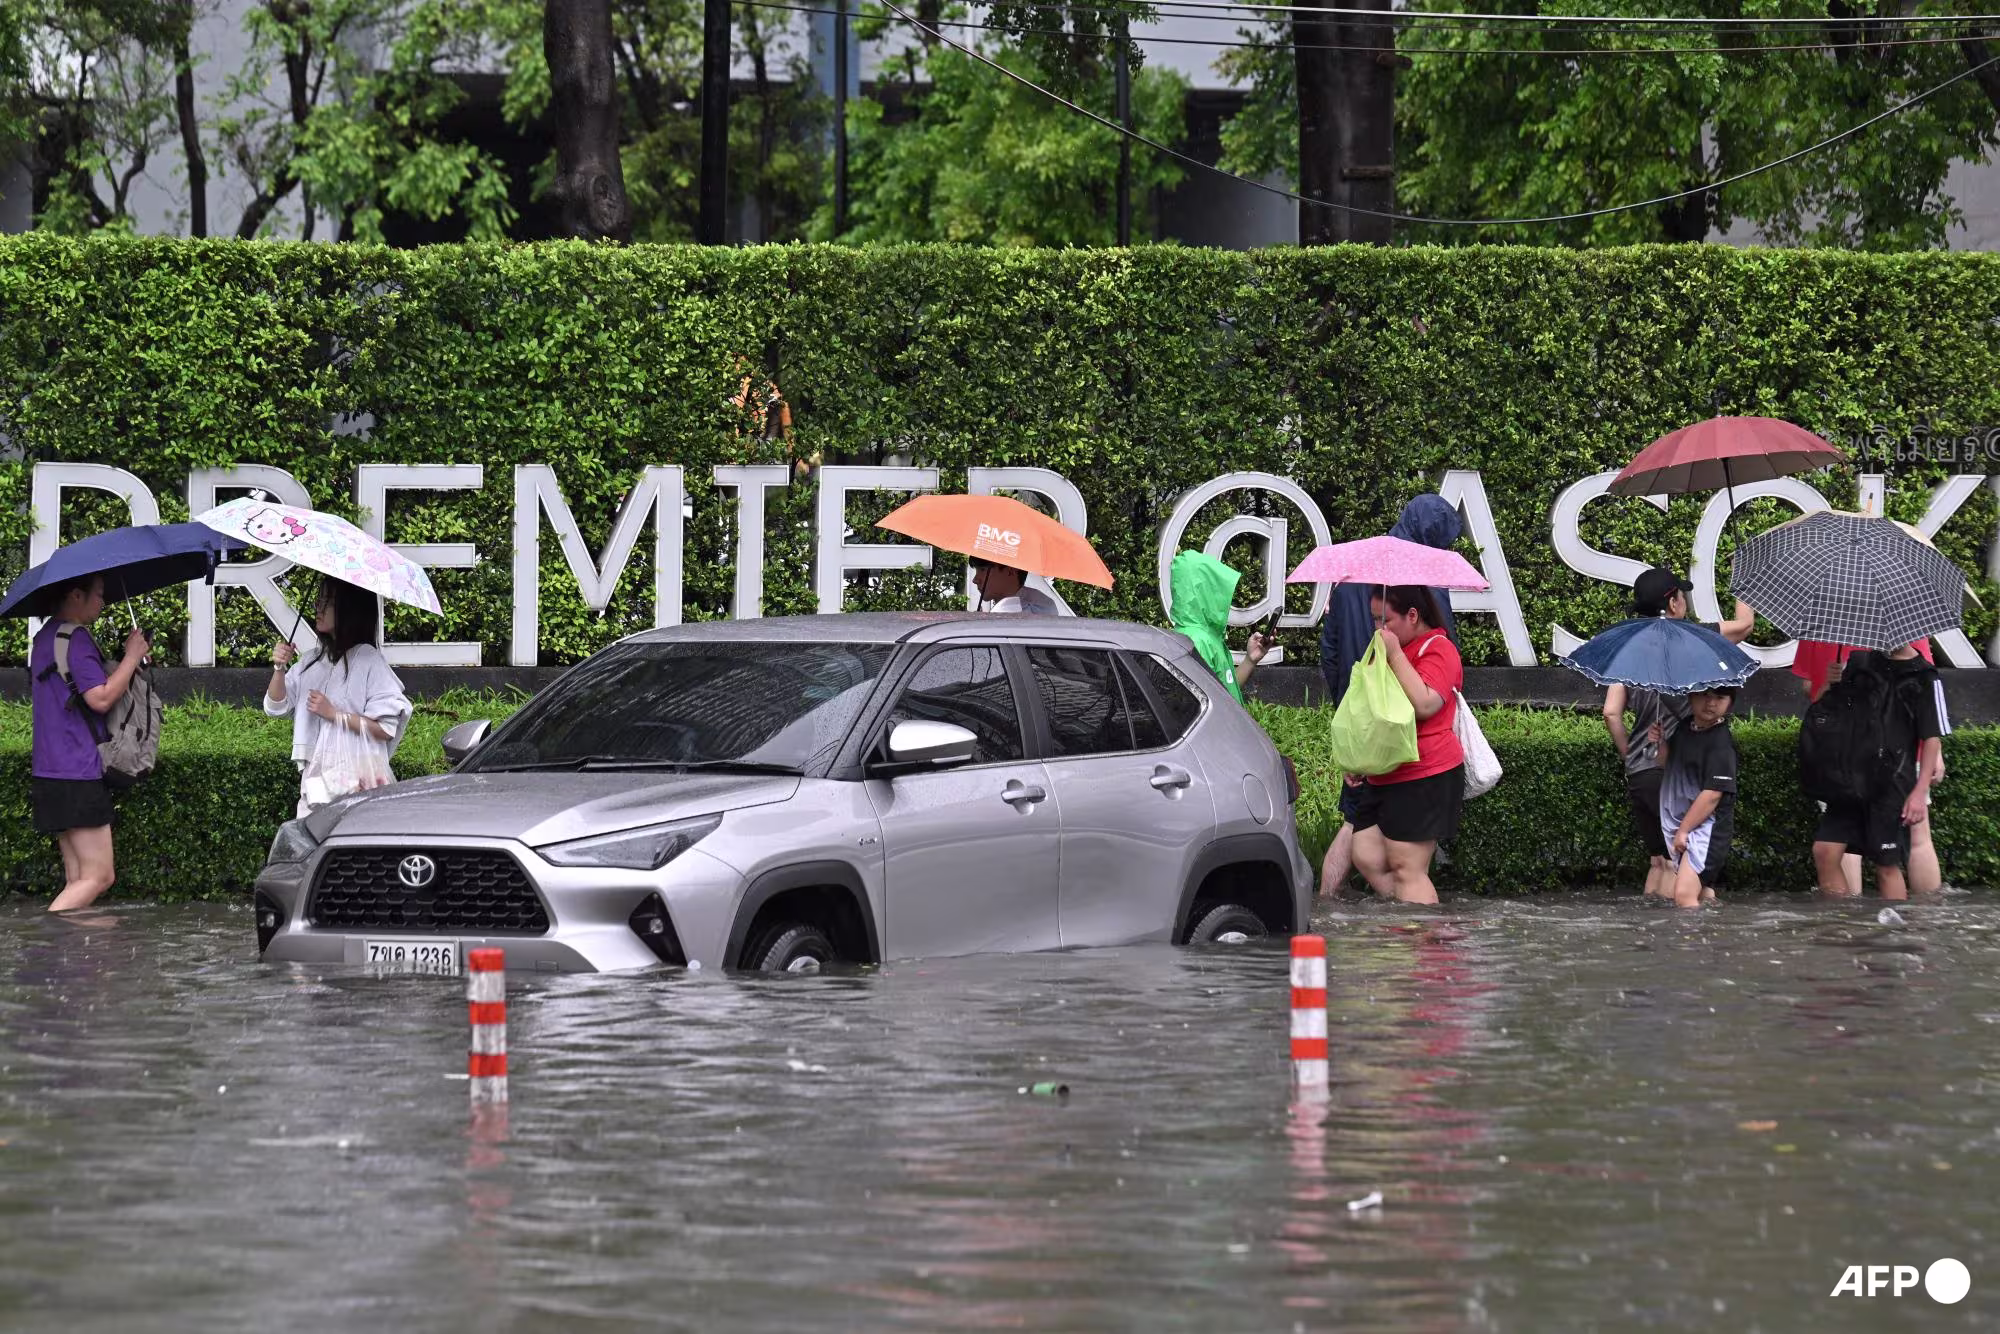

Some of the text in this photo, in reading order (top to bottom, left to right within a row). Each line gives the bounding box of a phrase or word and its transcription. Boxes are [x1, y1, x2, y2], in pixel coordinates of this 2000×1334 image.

[977, 523, 1022, 547] BMG
[28, 462, 2000, 670] PREMIER @ ASOK
[412, 946, 451, 967] 1236
